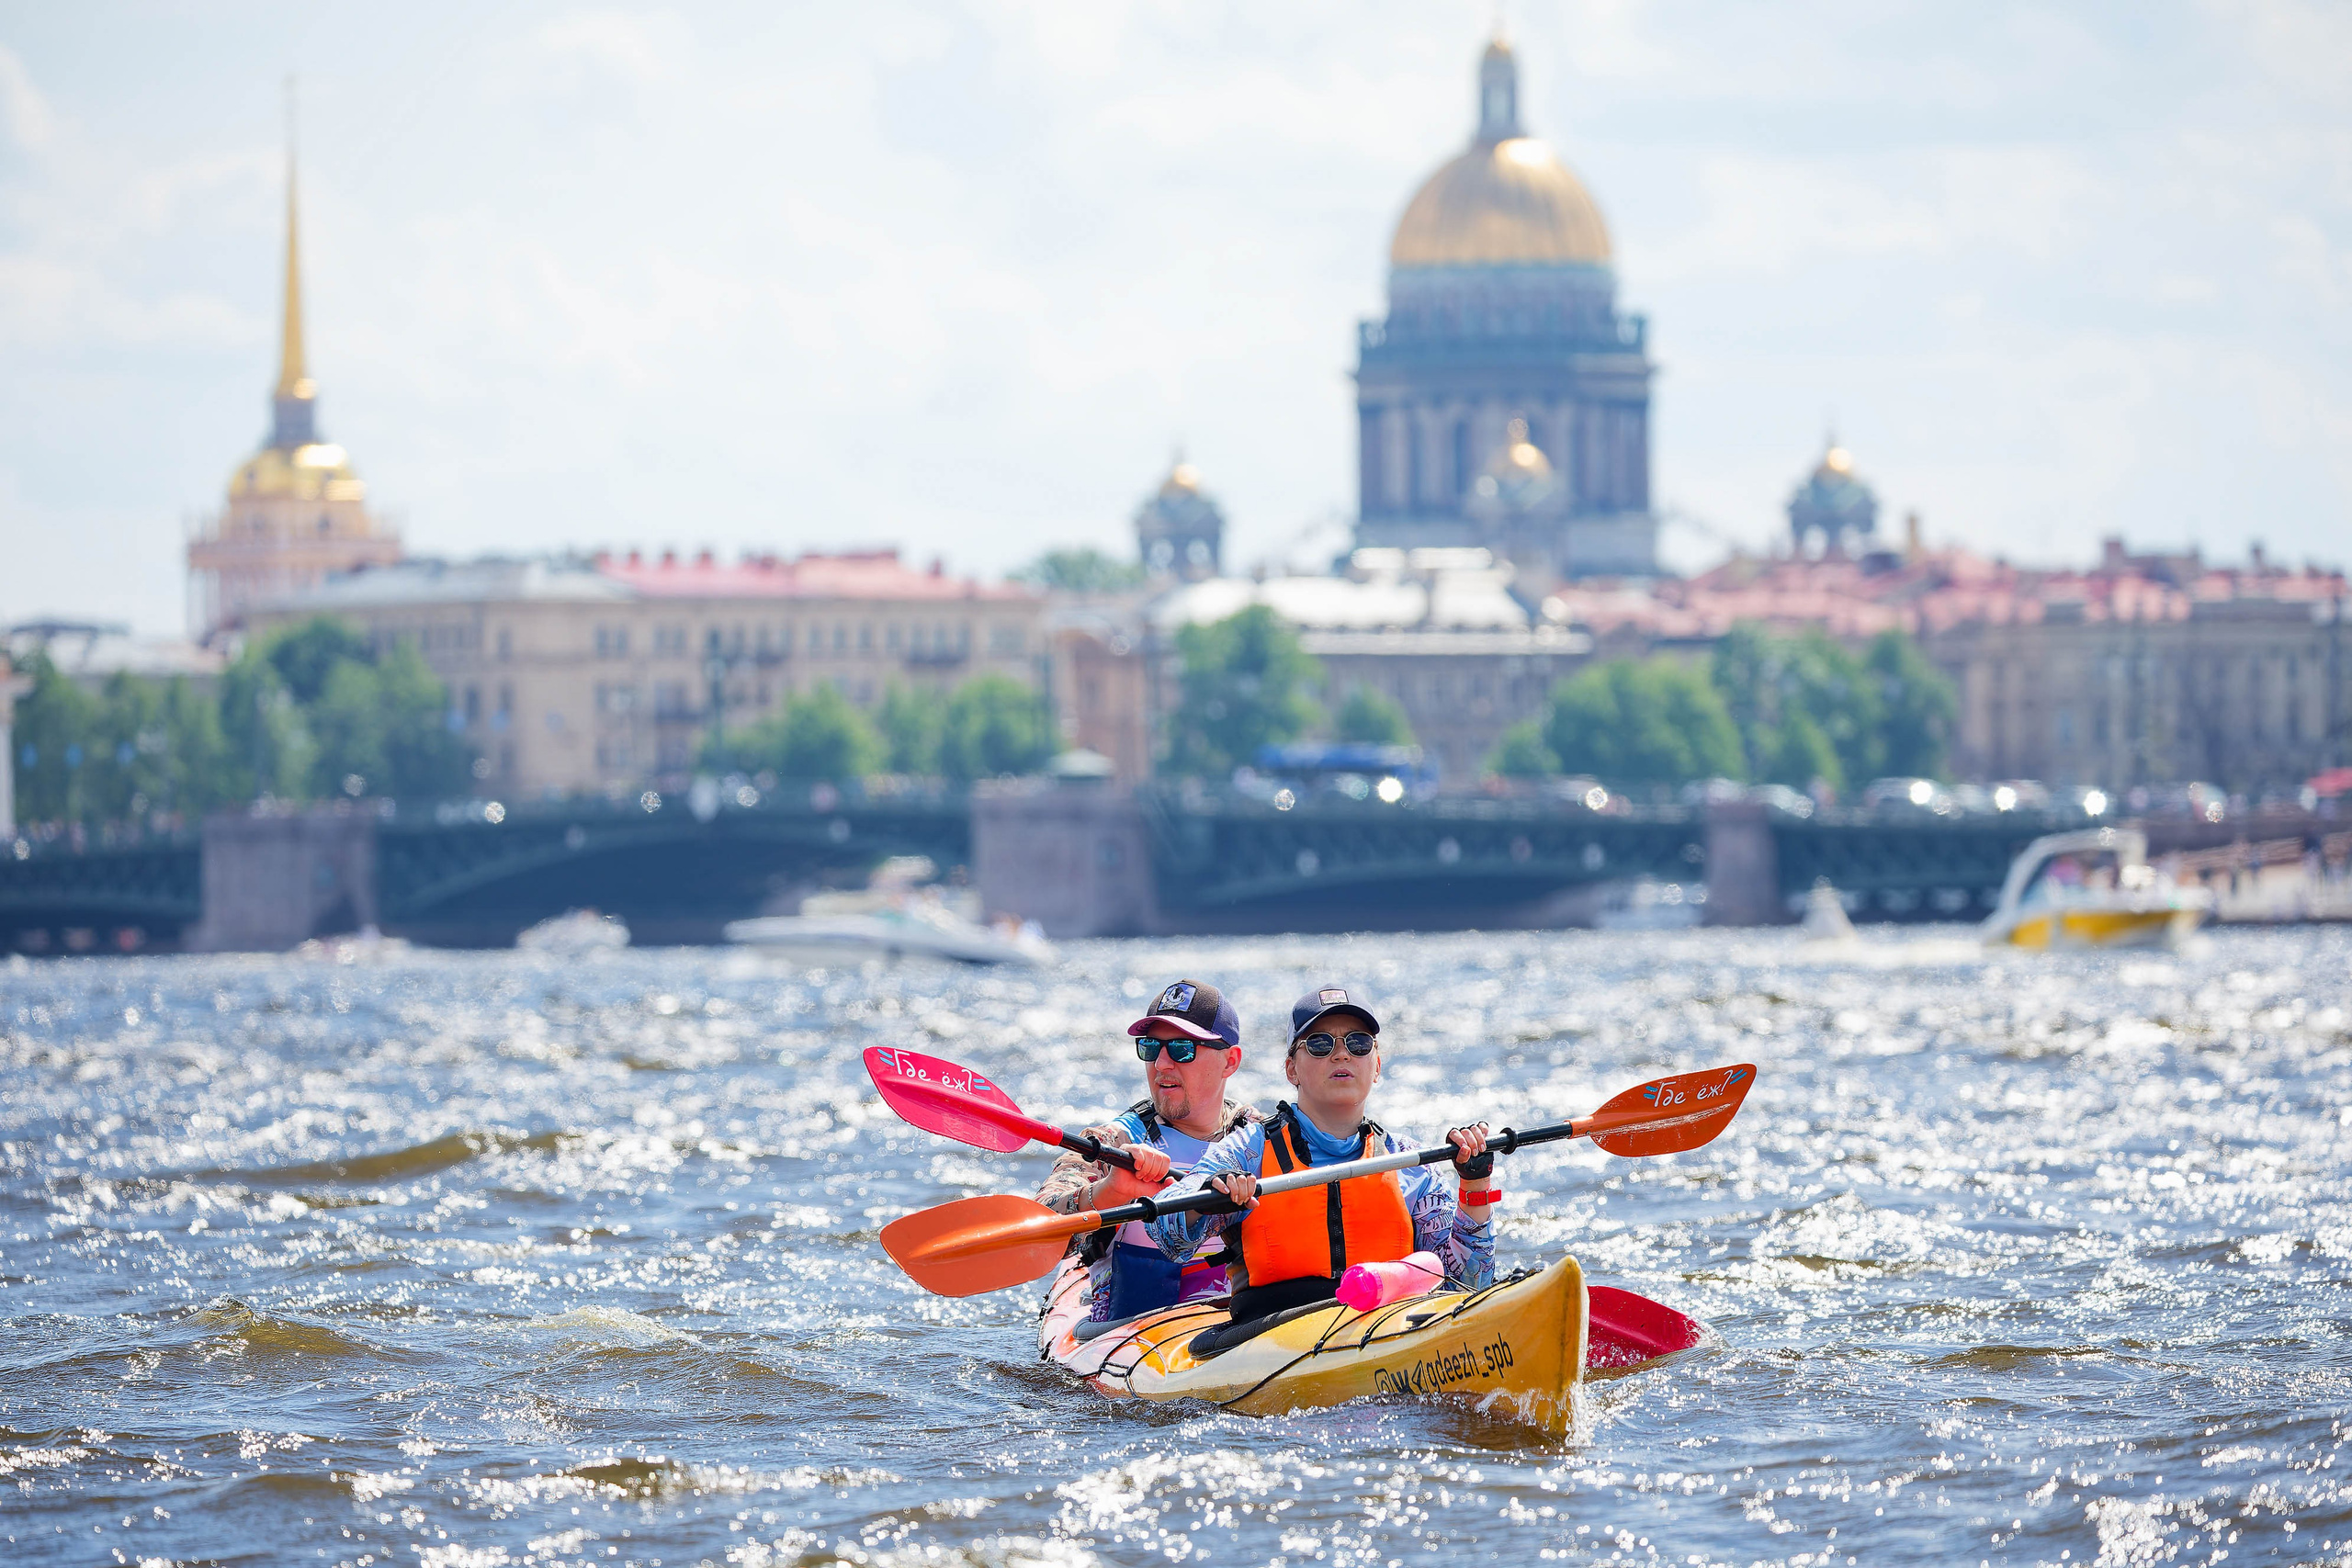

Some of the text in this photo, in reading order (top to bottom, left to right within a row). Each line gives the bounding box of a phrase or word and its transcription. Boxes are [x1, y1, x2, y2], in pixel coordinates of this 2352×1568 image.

[894, 1049, 973, 1094] Где ёж?
[1654, 1069, 1734, 1107] Где ёж?
[1426, 1332, 1514, 1393] gdeezh_spb
